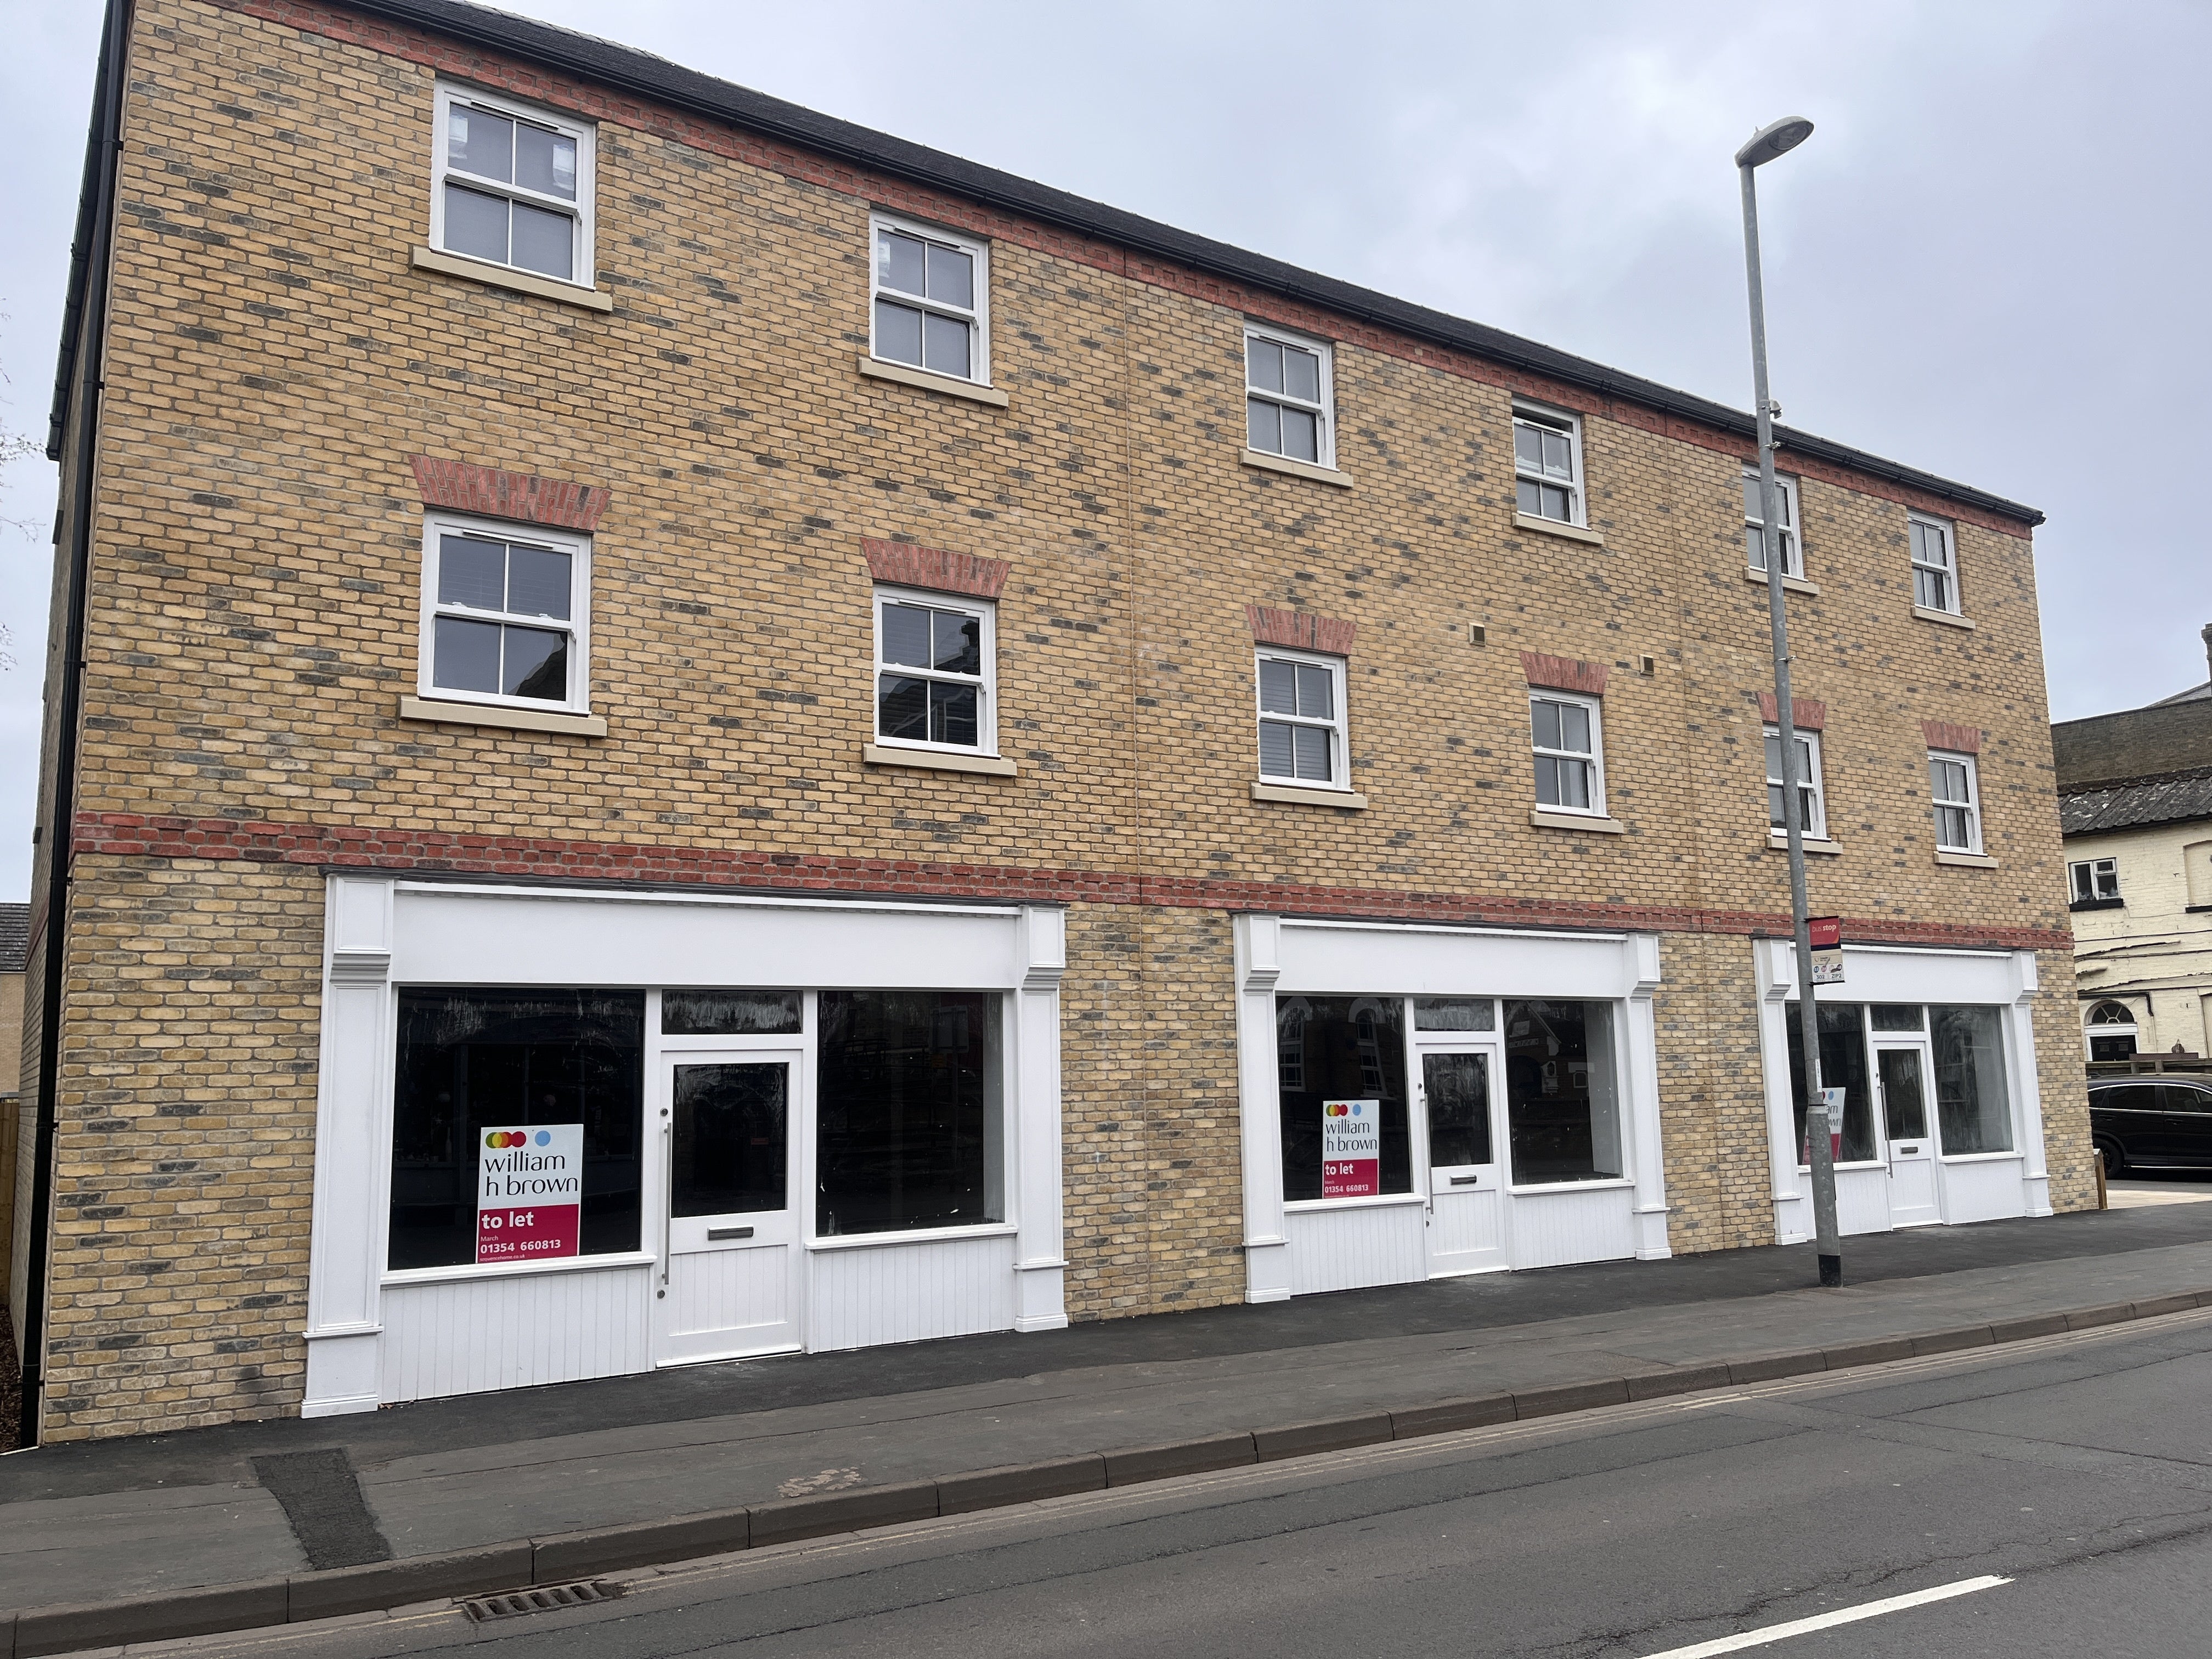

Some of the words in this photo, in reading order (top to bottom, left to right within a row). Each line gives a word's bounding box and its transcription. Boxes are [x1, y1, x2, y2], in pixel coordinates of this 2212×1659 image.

[1325, 1119, 1370, 1135] william
[1327, 1136, 1334, 1152] h
[1338, 1136, 1377, 1152] brown
[484, 1150, 565, 1173] william
[1325, 1164, 1336, 1176] to
[1339, 1162, 1353, 1175] let
[486, 1176, 499, 1197] h
[506, 1175, 578, 1195] brown
[1324, 1185, 1344, 1194] 01354
[1346, 1184, 1369, 1193] 660813
[481, 1214, 503, 1229] to
[509, 1211, 534, 1228] let
[480, 1242, 515, 1254] 01354
[520, 1239, 561, 1251] 660813
